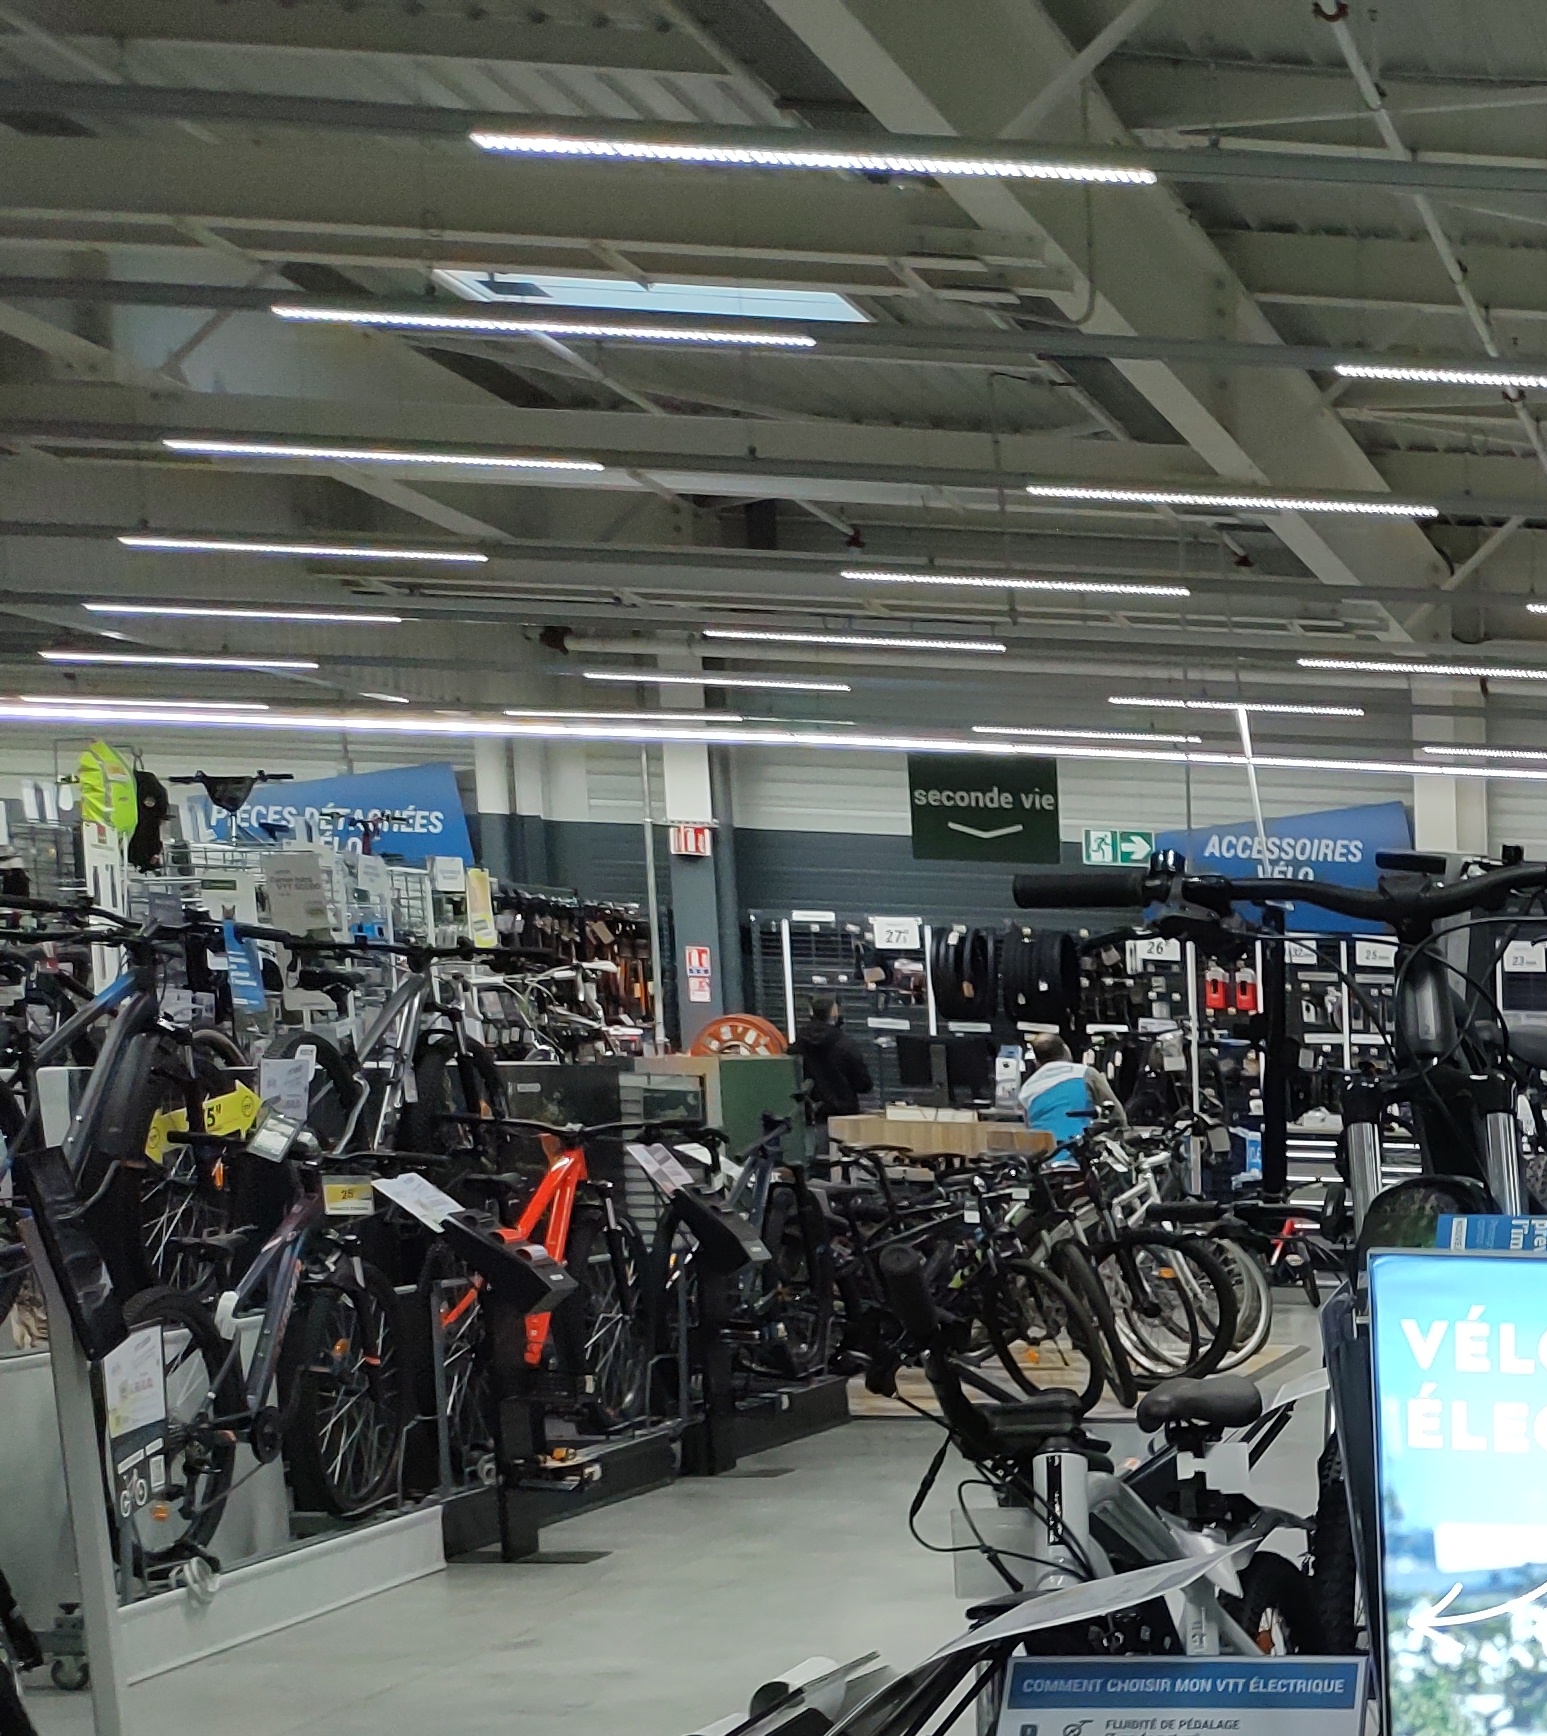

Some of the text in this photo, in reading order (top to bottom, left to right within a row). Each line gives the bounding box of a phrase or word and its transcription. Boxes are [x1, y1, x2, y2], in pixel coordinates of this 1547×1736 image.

[913, 785, 1055, 811] seconde vie
[1204, 834, 1364, 863] ACCESSOIRES
[1022, 1675, 1345, 1694] COMMENT CHOISIR MON VTT ÉLECTRIQUE
[1105, 1717, 1240, 1731] FLUIDITÉ DE PÉDALAGE
